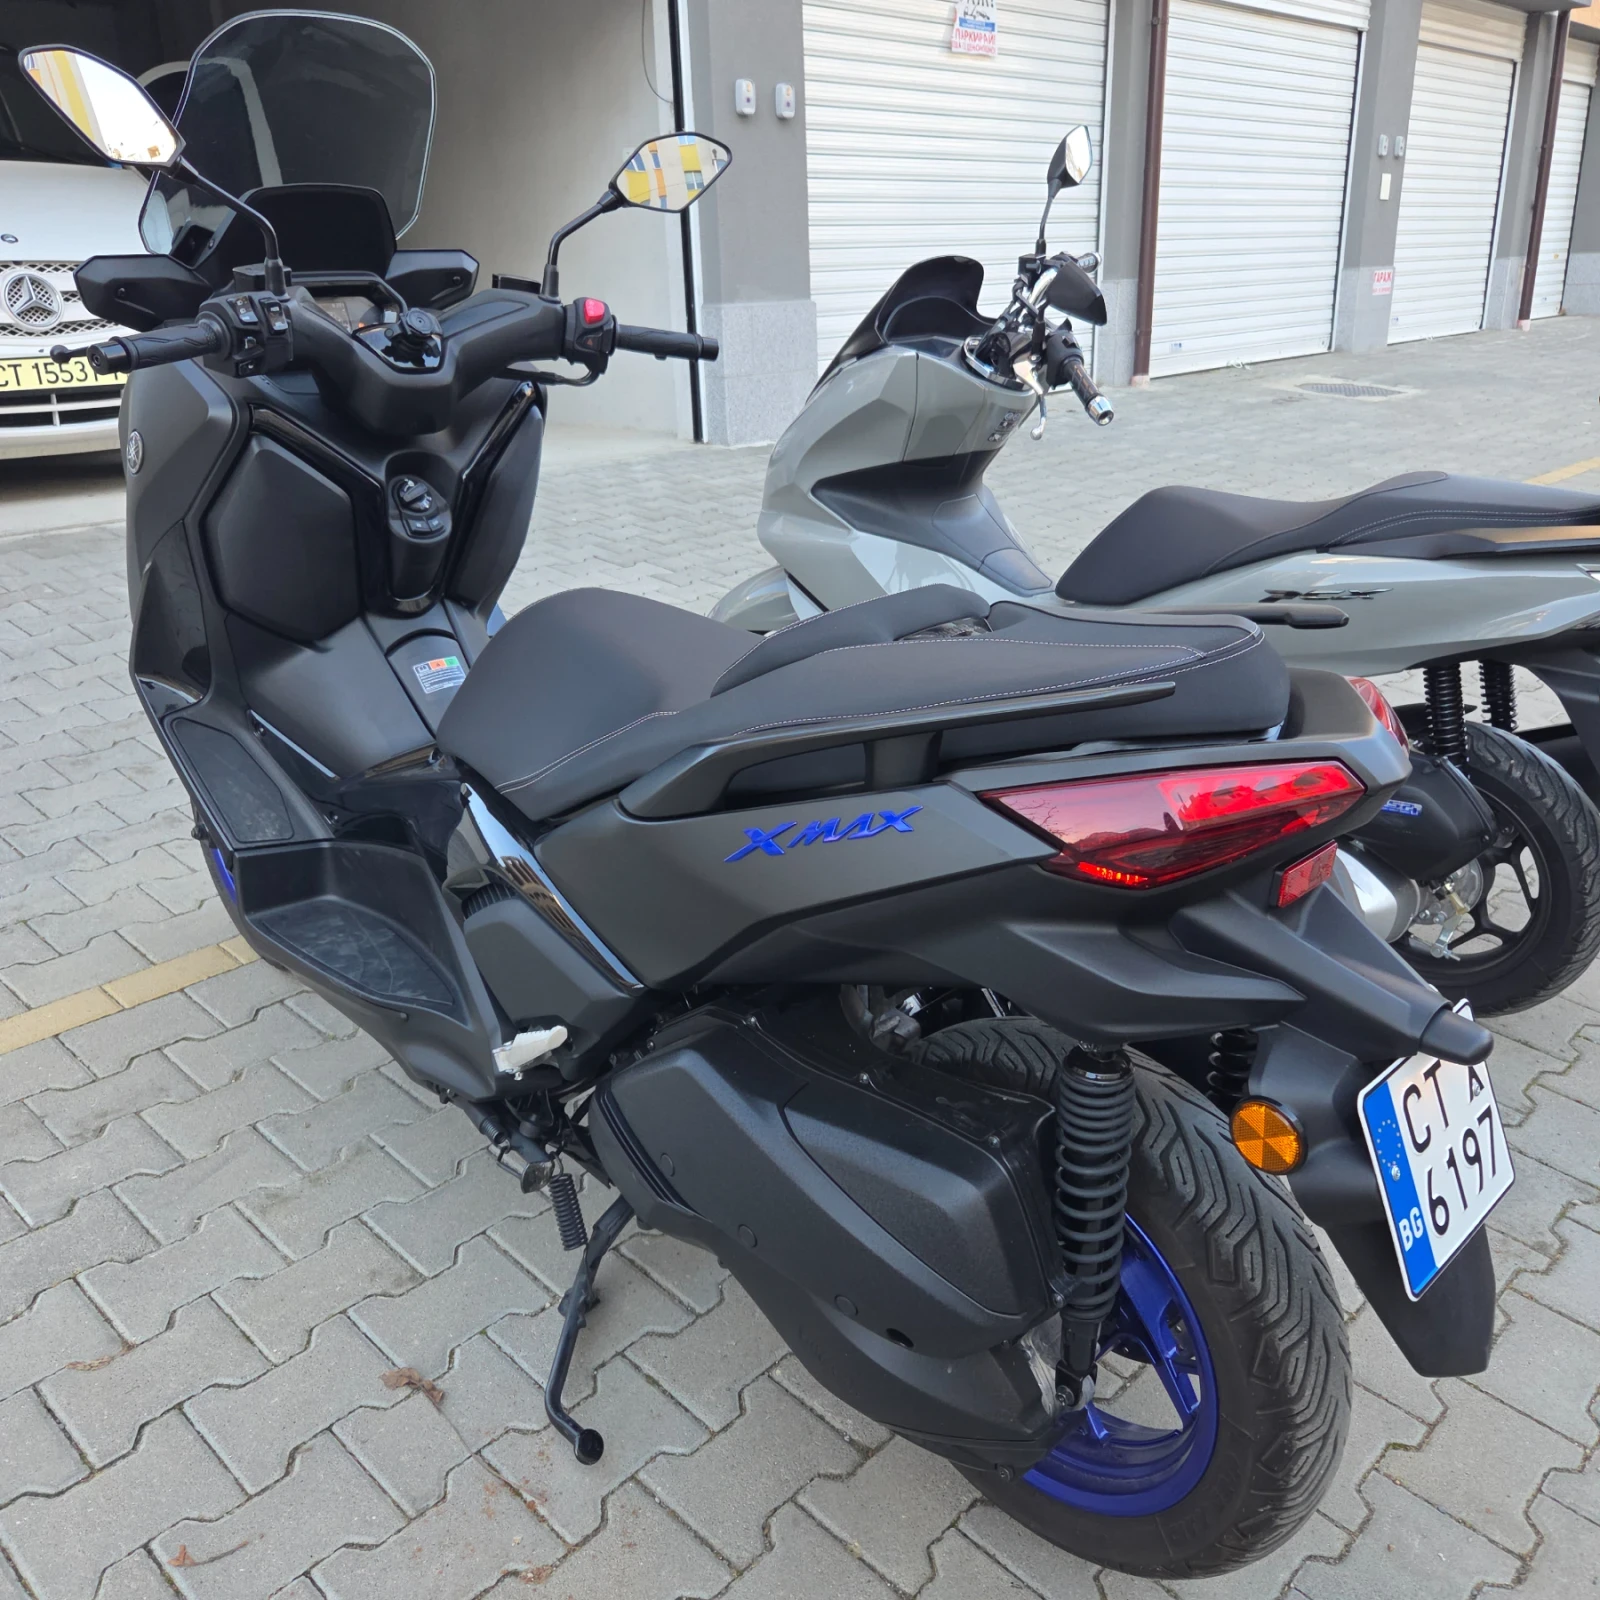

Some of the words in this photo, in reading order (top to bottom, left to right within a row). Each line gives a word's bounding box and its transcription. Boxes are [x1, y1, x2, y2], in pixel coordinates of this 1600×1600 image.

[32, 361, 88, 385] 1553
[1403, 1059, 1449, 1154] CT
[1427, 1104, 1497, 1236] 6197
[1399, 1207, 1424, 1252] BG
